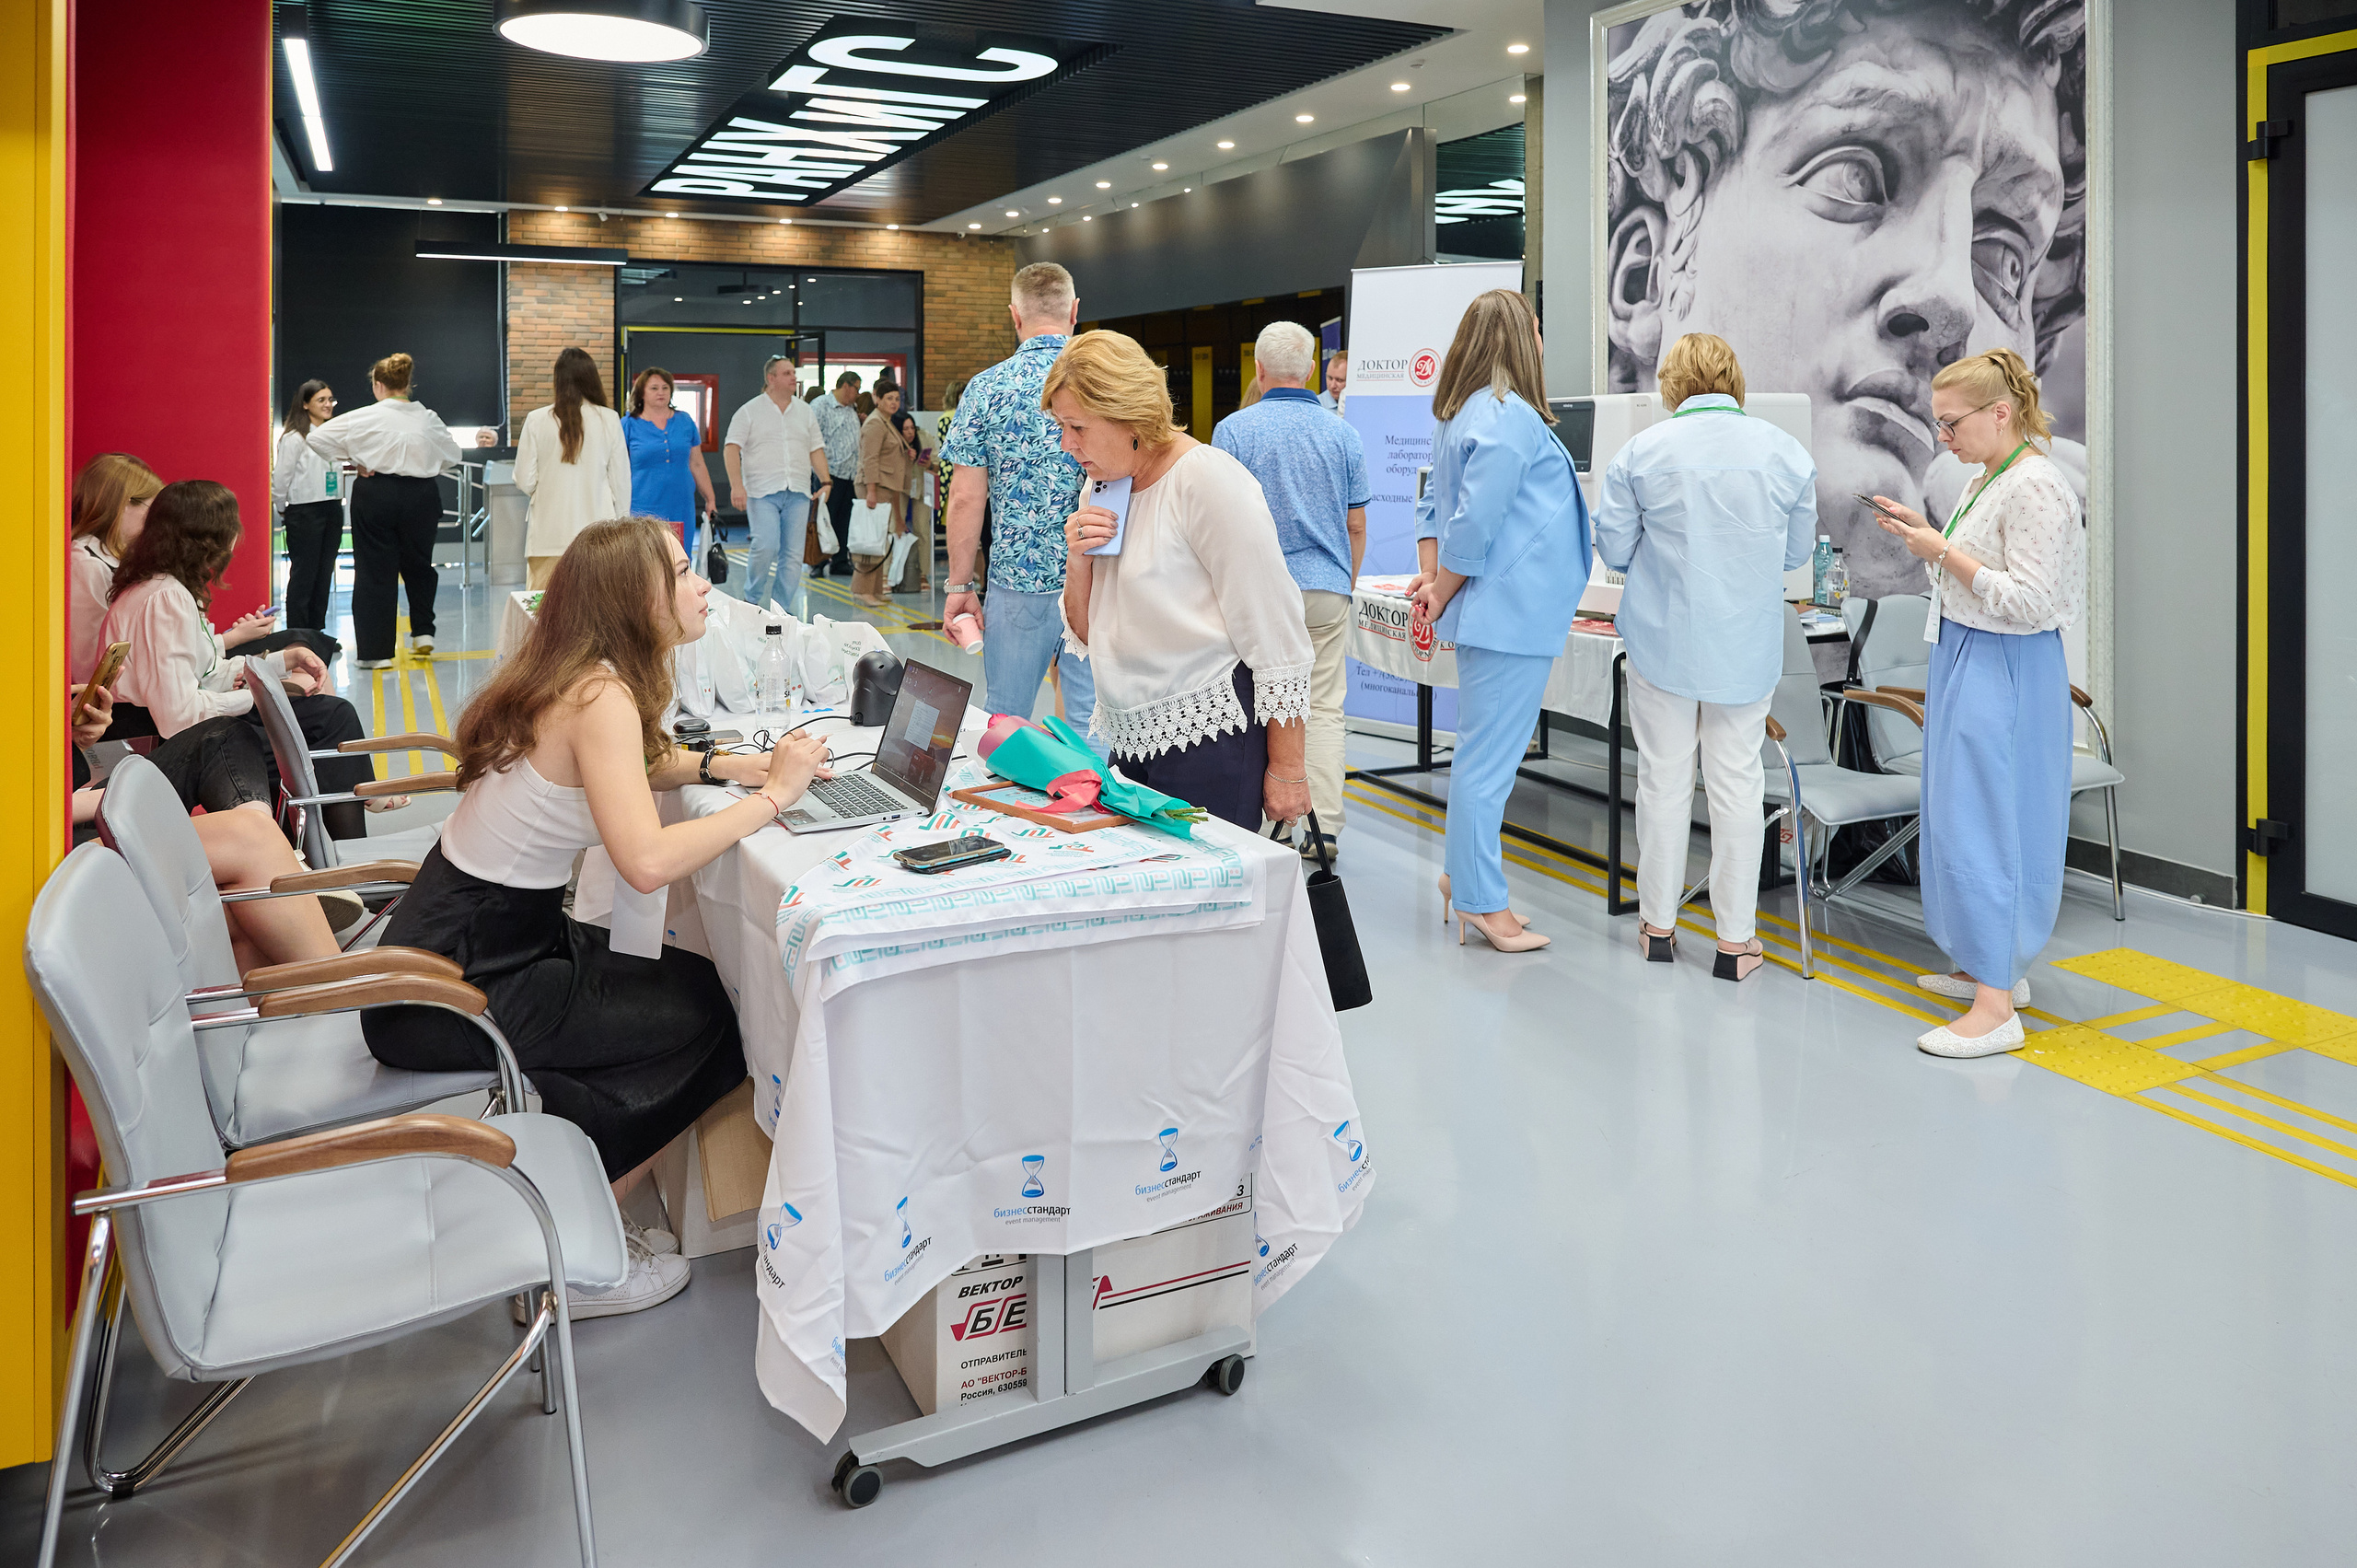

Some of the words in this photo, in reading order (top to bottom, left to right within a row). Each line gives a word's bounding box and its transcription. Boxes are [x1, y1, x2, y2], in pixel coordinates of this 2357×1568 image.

[1357, 359, 1409, 371] ДОКТОР
[1358, 600, 1409, 627] ДОКТОР
[1356, 666, 1370, 677] Тел
[1134, 1170, 1202, 1195] бизнесстандарт
[1146, 1194, 1160, 1202] event
[1161, 1183, 1191, 1198] management
[993, 1204, 1072, 1218] бизнесстандарт
[1004, 1217, 1016, 1225] event
[1016, 1216, 1061, 1225] management
[884, 1236, 932, 1283] бизнесстандарт
[958, 1275, 1024, 1299] ВЕКТОР
[960, 1378, 975, 1389] АО
[960, 1388, 995, 1401] Россия,
[997, 1377, 1028, 1393] 630559
